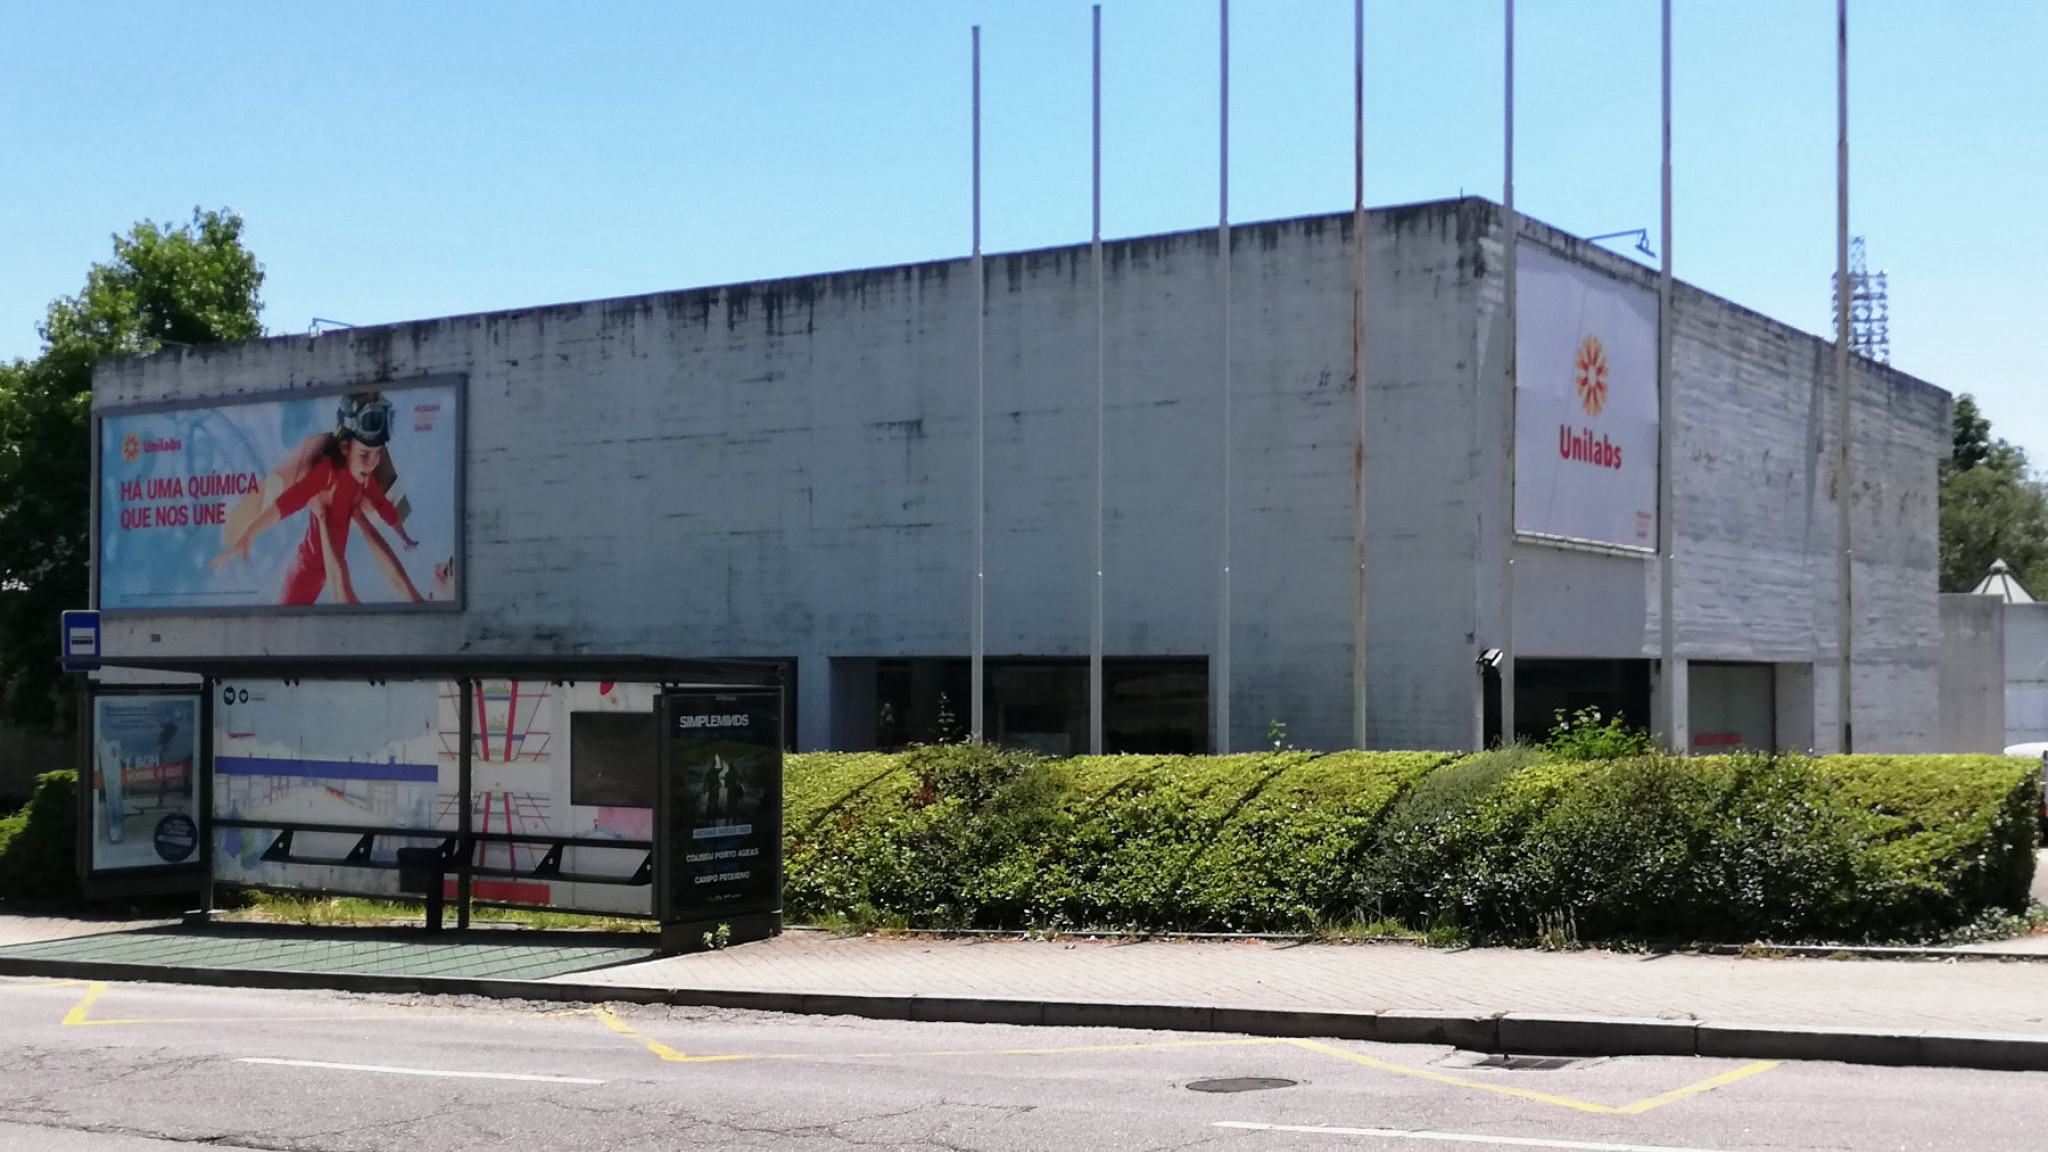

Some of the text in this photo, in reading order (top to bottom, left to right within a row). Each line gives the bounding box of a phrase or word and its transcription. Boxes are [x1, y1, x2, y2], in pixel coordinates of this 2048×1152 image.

[143, 437, 182, 453] Unilabs
[1559, 424, 1622, 470] Unilabs
[121, 468, 259, 501] HÁ UMA QUÍMICA
[121, 503, 226, 531] QUE NOS UNE
[686, 852, 714, 863] COLISEU
[715, 850, 736, 860] PORTO
[694, 873, 718, 885] CAMPO
